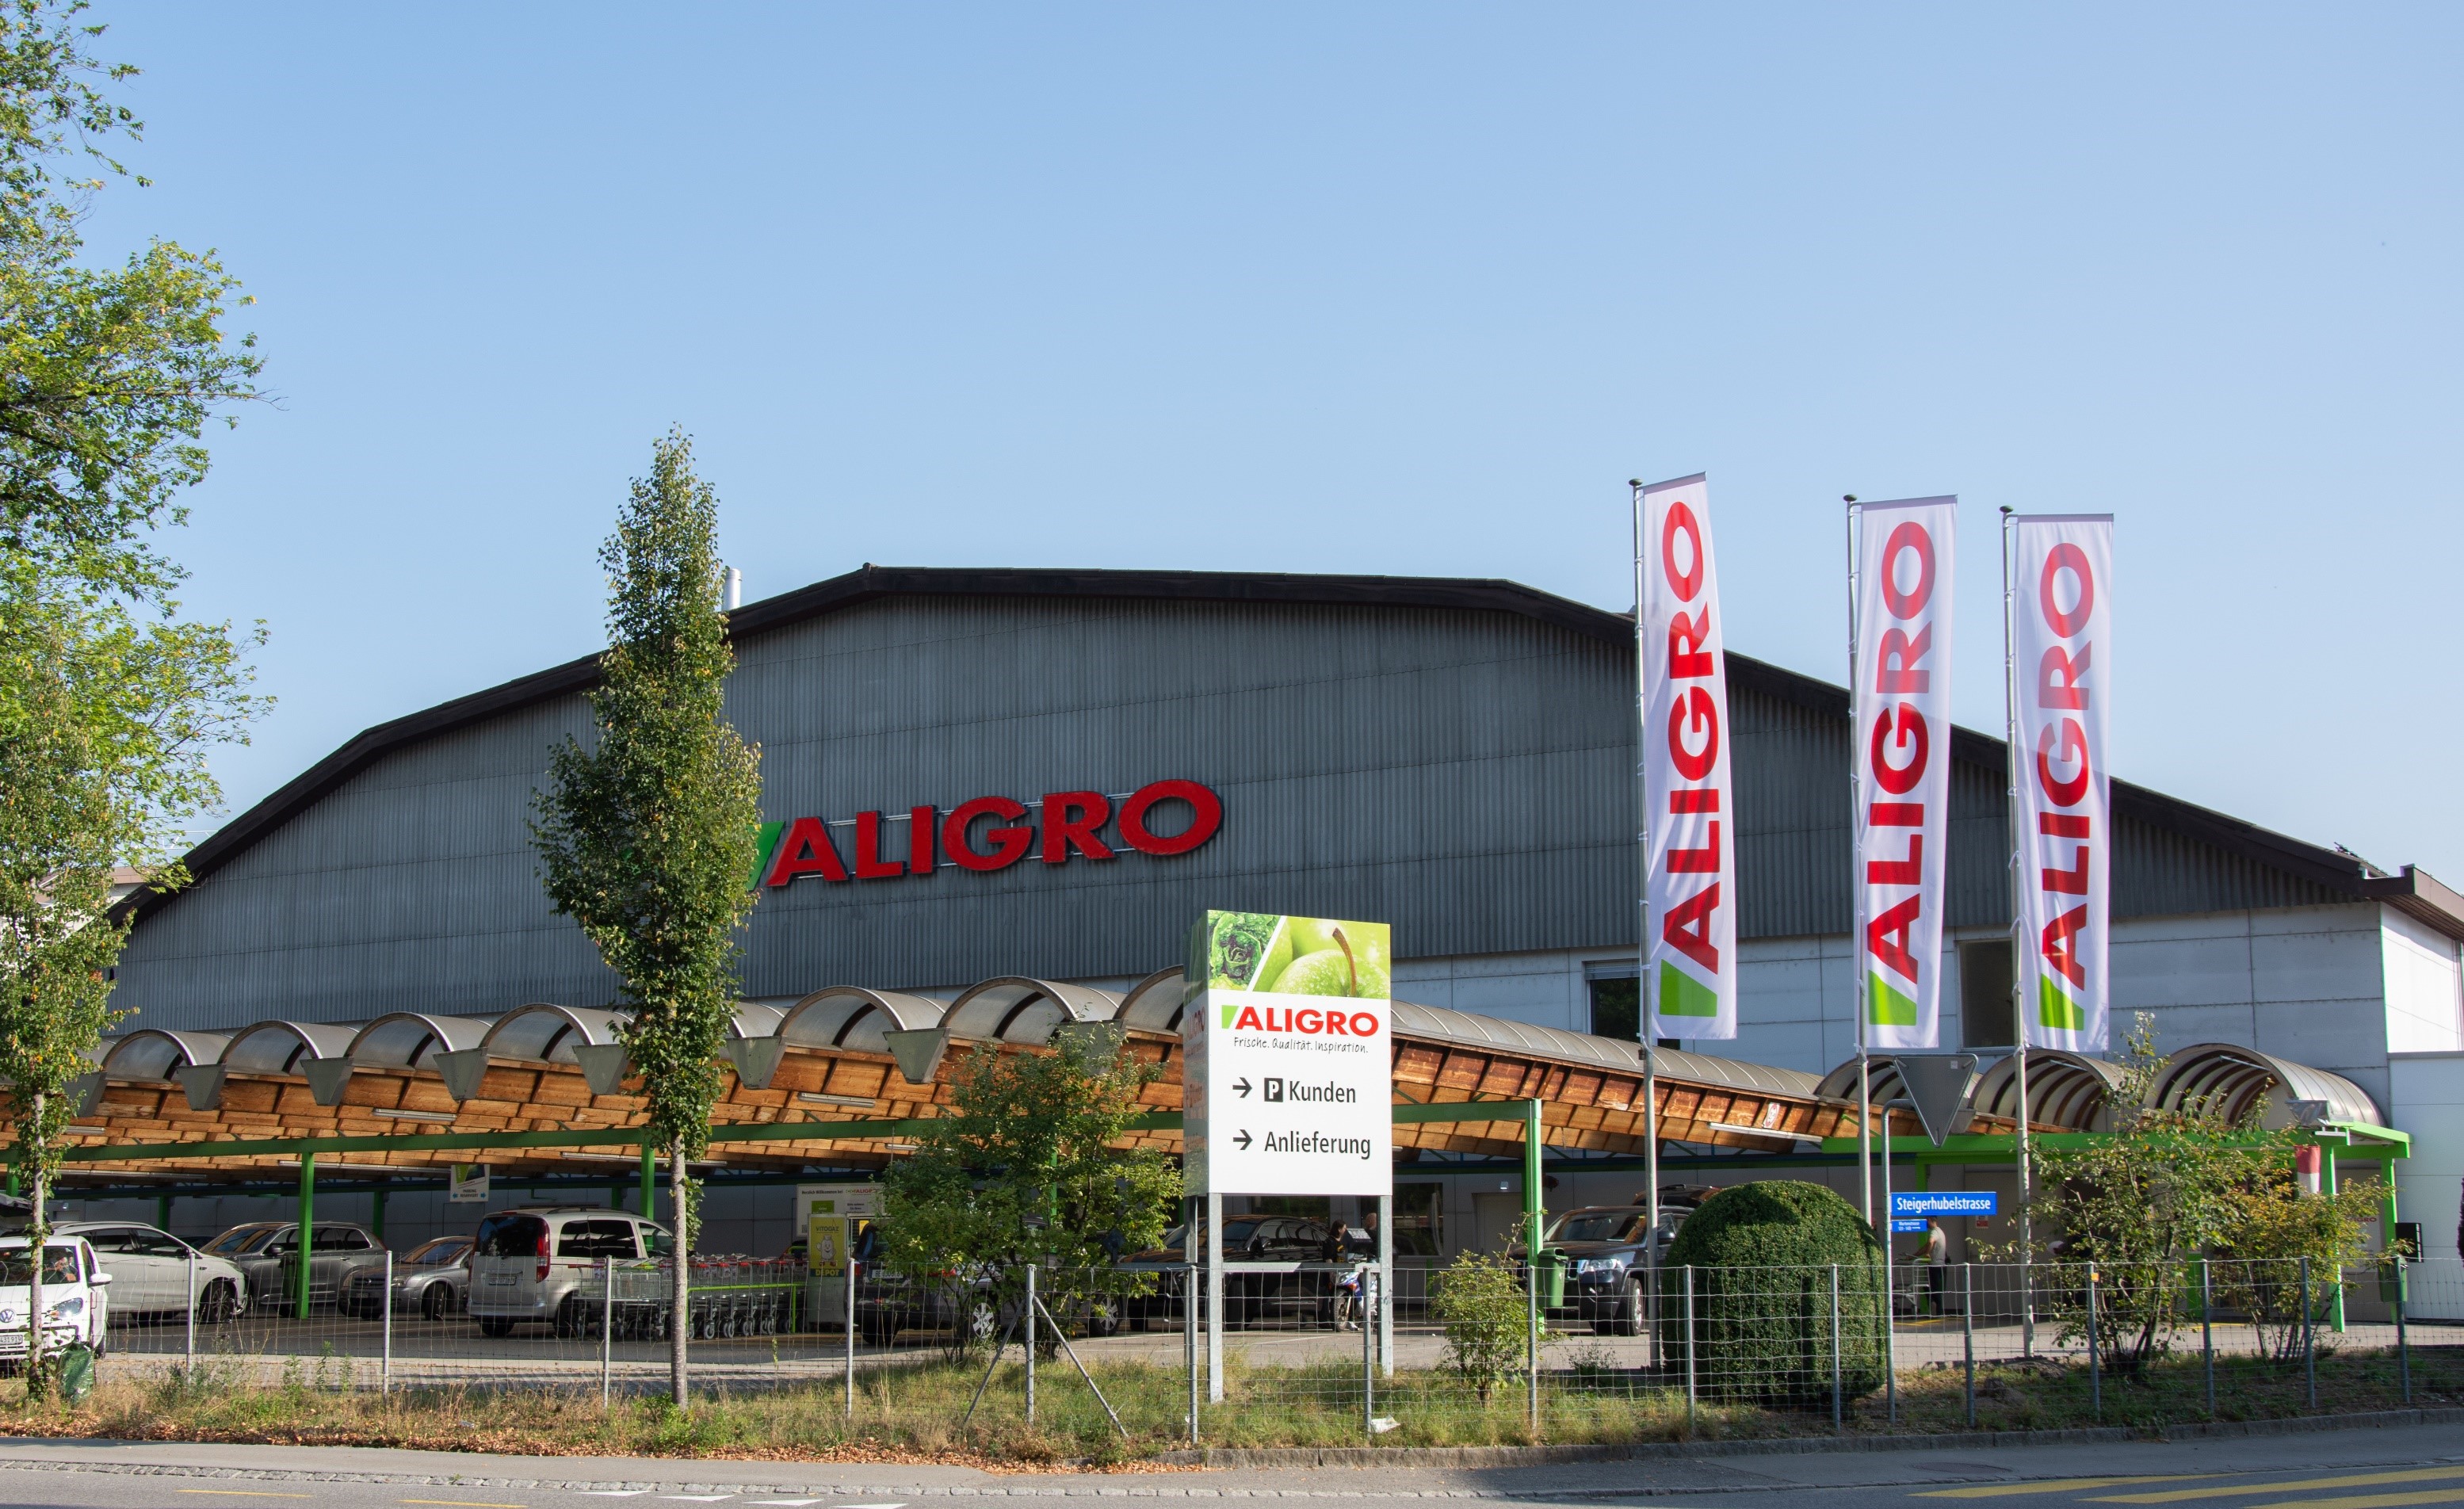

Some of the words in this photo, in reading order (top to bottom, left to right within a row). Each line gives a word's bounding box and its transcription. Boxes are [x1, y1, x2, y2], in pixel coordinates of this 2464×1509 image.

[1661, 501, 1721, 974] ALIGRO
[1867, 521, 1936, 984] ALIGRO
[2038, 543, 2094, 991] ALIGRO
[766, 778, 1224, 888] ALIGRO
[1235, 1006, 1379, 1037] ALIGRO
[1234, 1037, 1270, 1048] Frische.
[1272, 1037, 1312, 1050] Qualität.
[1315, 1040, 1369, 1054] Inspiration.
[1268, 1080, 1280, 1100] P
[1289, 1080, 1356, 1103] Kunden
[1264, 1130, 1370, 1160] Anlieferung
[1897, 1196, 1992, 1213] Steigerhubelstrasse
